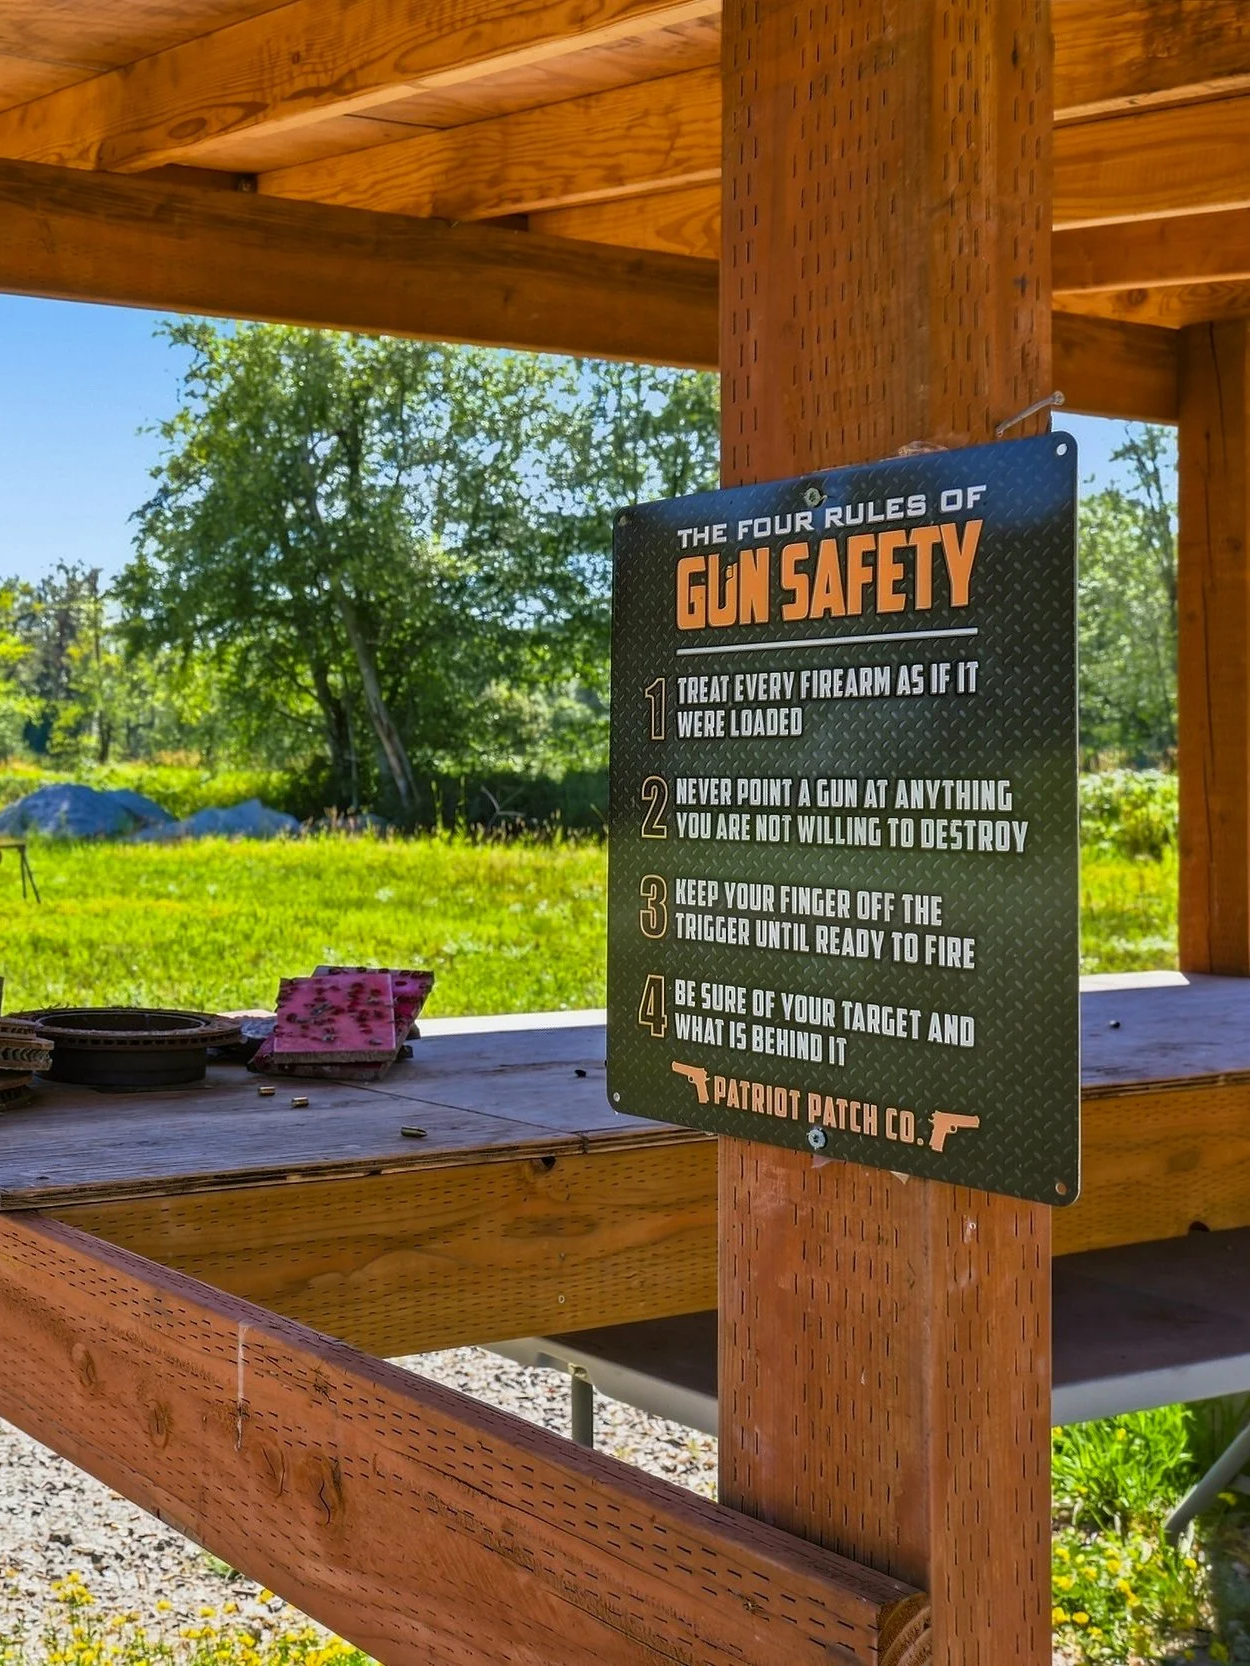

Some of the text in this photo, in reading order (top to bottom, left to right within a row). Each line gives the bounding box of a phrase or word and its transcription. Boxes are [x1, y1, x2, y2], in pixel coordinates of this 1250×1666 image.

[678, 485, 986, 548] THE FOUR RULES OF
[676, 519, 983, 630] GUN SAFETY
[644, 677, 665, 741] 1
[678, 661, 978, 704] TREAT EVERY FIREARM AS IF IT
[677, 708, 802, 739] WERE LOADED
[641, 776, 668, 839] 2
[676, 778, 1012, 811] NEVER POINT A GUN AT ANYTHING
[676, 812, 1028, 853] YOU ARE NOT WILLING TO DESTROY
[639, 874, 668, 939] 3
[675, 878, 942, 926] KEEP YOUR FINGER OFF THE
[675, 913, 975, 969] TRIGGER UNTIL READY TO FIRE
[638, 974, 667, 1038] 4
[675, 979, 975, 1048] BE SURE OF YOUR TARGET AND
[675, 1013, 847, 1066] WHAT IS BEHIND IT
[713, 1076, 924, 1146] PATRIOT PATCH CO.
